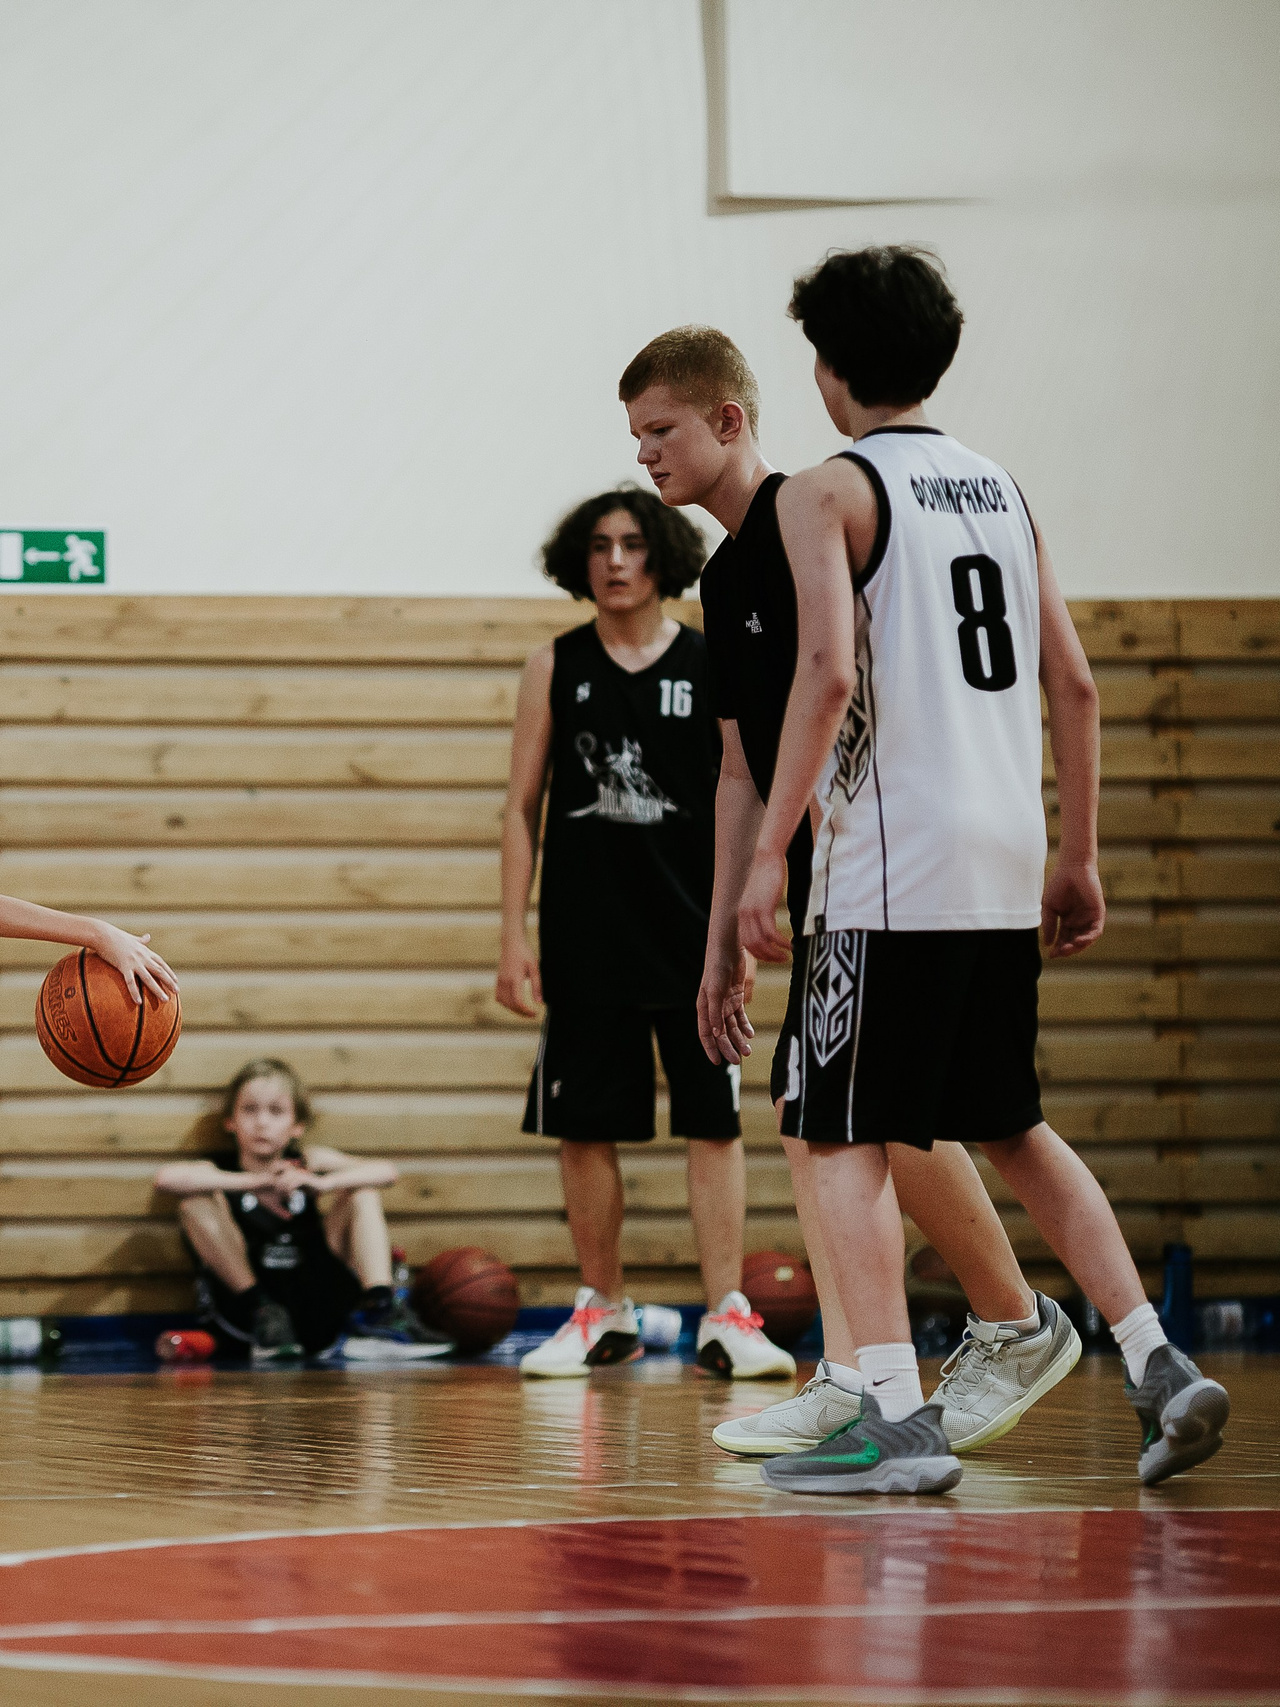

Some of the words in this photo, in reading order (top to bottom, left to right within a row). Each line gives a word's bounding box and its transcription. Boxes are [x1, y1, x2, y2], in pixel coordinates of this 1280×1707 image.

[950, 552, 1017, 692] 8
[659, 678, 694, 718] 16
[48, 960, 78, 1043] ORRES
